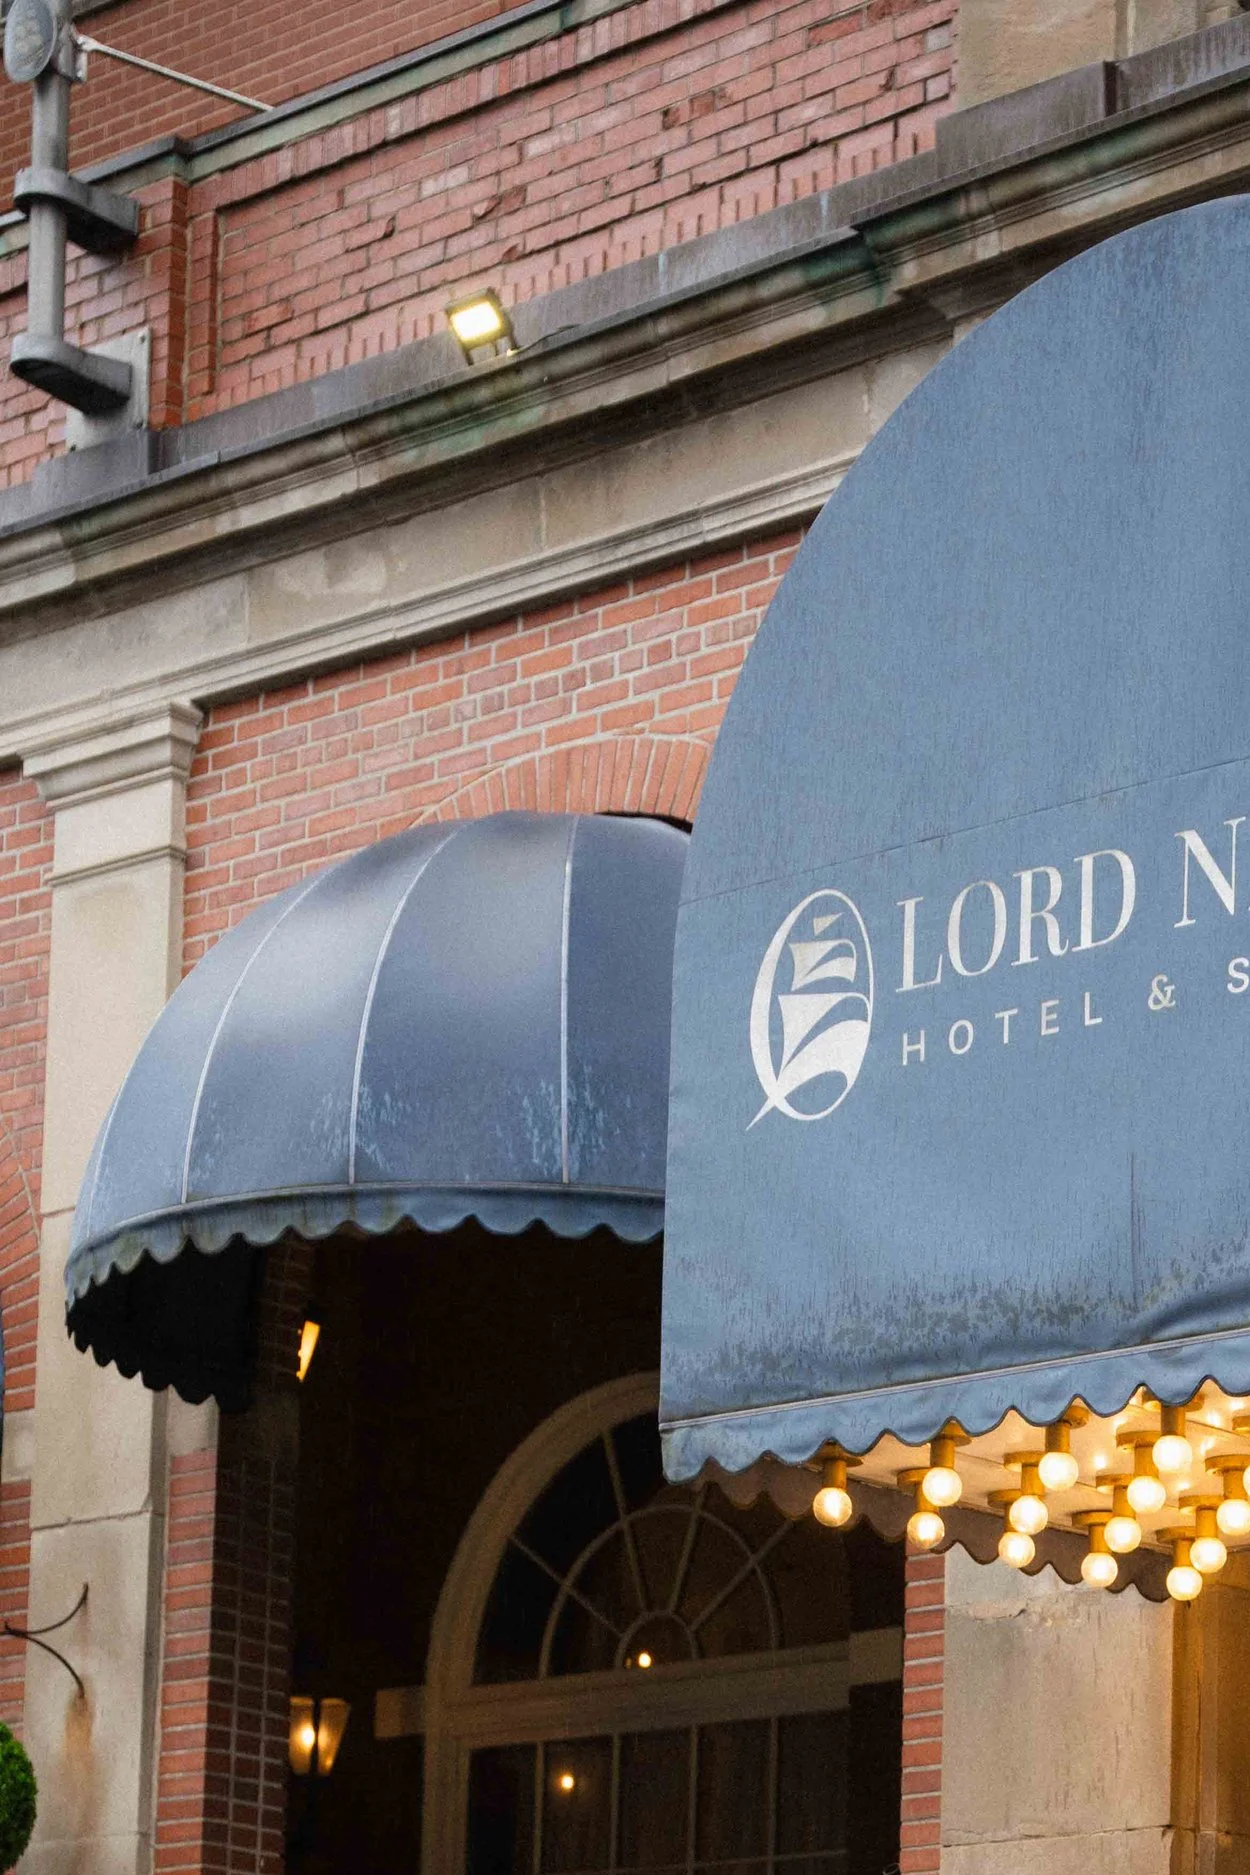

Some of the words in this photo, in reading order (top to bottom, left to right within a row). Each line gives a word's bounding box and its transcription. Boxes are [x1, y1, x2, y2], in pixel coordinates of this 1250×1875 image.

[896, 850, 1136, 993] LORD
[902, 991, 1103, 1066] HOTEL
[1147, 974, 1176, 1011] &
